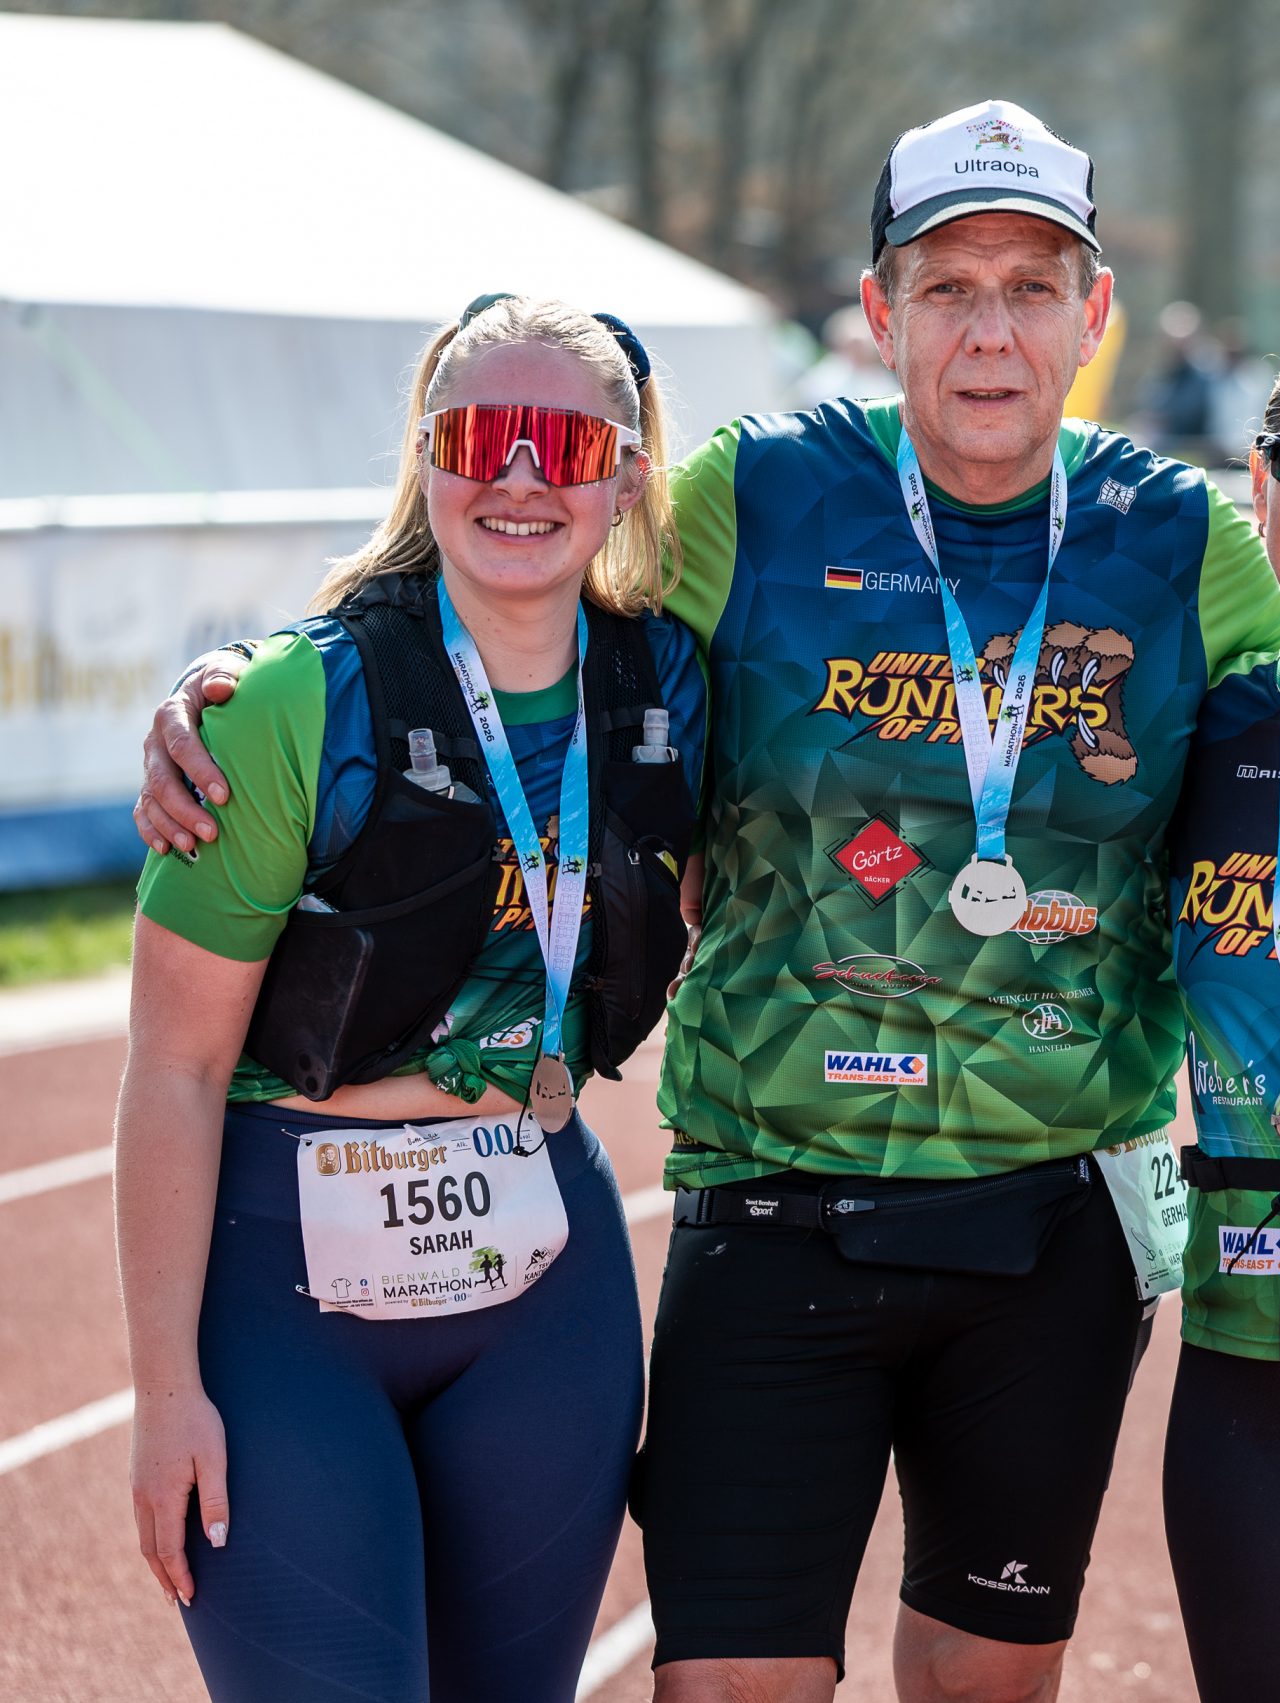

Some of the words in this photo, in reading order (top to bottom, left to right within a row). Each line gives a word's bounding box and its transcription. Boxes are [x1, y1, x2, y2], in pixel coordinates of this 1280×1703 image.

[954, 158, 1040, 179] Ultraopa
[865, 571, 961, 596] GERMANY
[866, 652, 986, 677] UNIT
[454, 652, 476, 695] MARATHON
[479, 716, 495, 743] 2026
[877, 718, 929, 741] OF
[1003, 722, 1019, 768] MARATHON
[1014, 674, 1027, 700] 2026
[853, 844, 902, 871] Görtz
[864, 876, 891, 884] BÄCKER
[1012, 899, 1098, 935] lobus
[1215, 927, 1269, 956] OF
[988, 992, 1040, 1004] WEINGUT
[1041, 987, 1096, 1000] HUNDEMER
[1028, 1043, 1071, 1054] HAINFELD
[826, 1054, 897, 1073] WAHL
[826, 1073, 897, 1083] TRANS-EAST
[898, 1076, 925, 1085] GmbH
[1212, 1096, 1264, 1107] RESTAURANT
[472, 1123, 514, 1158] 0.0
[343, 1140, 447, 1175] Bitburger
[379, 1171, 491, 1229] 1560
[409, 1229, 474, 1256] SARAH
[1223, 1231, 1274, 1255] WAHL
[1222, 1257, 1275, 1270] TRNS-EAST
[381, 1267, 460, 1285] BIENWALD
[383, 1277, 472, 1299] MARATHON
[418, 1297, 448, 1308] Bitburger
[967, 1572, 1051, 1595] KOSSMANN
